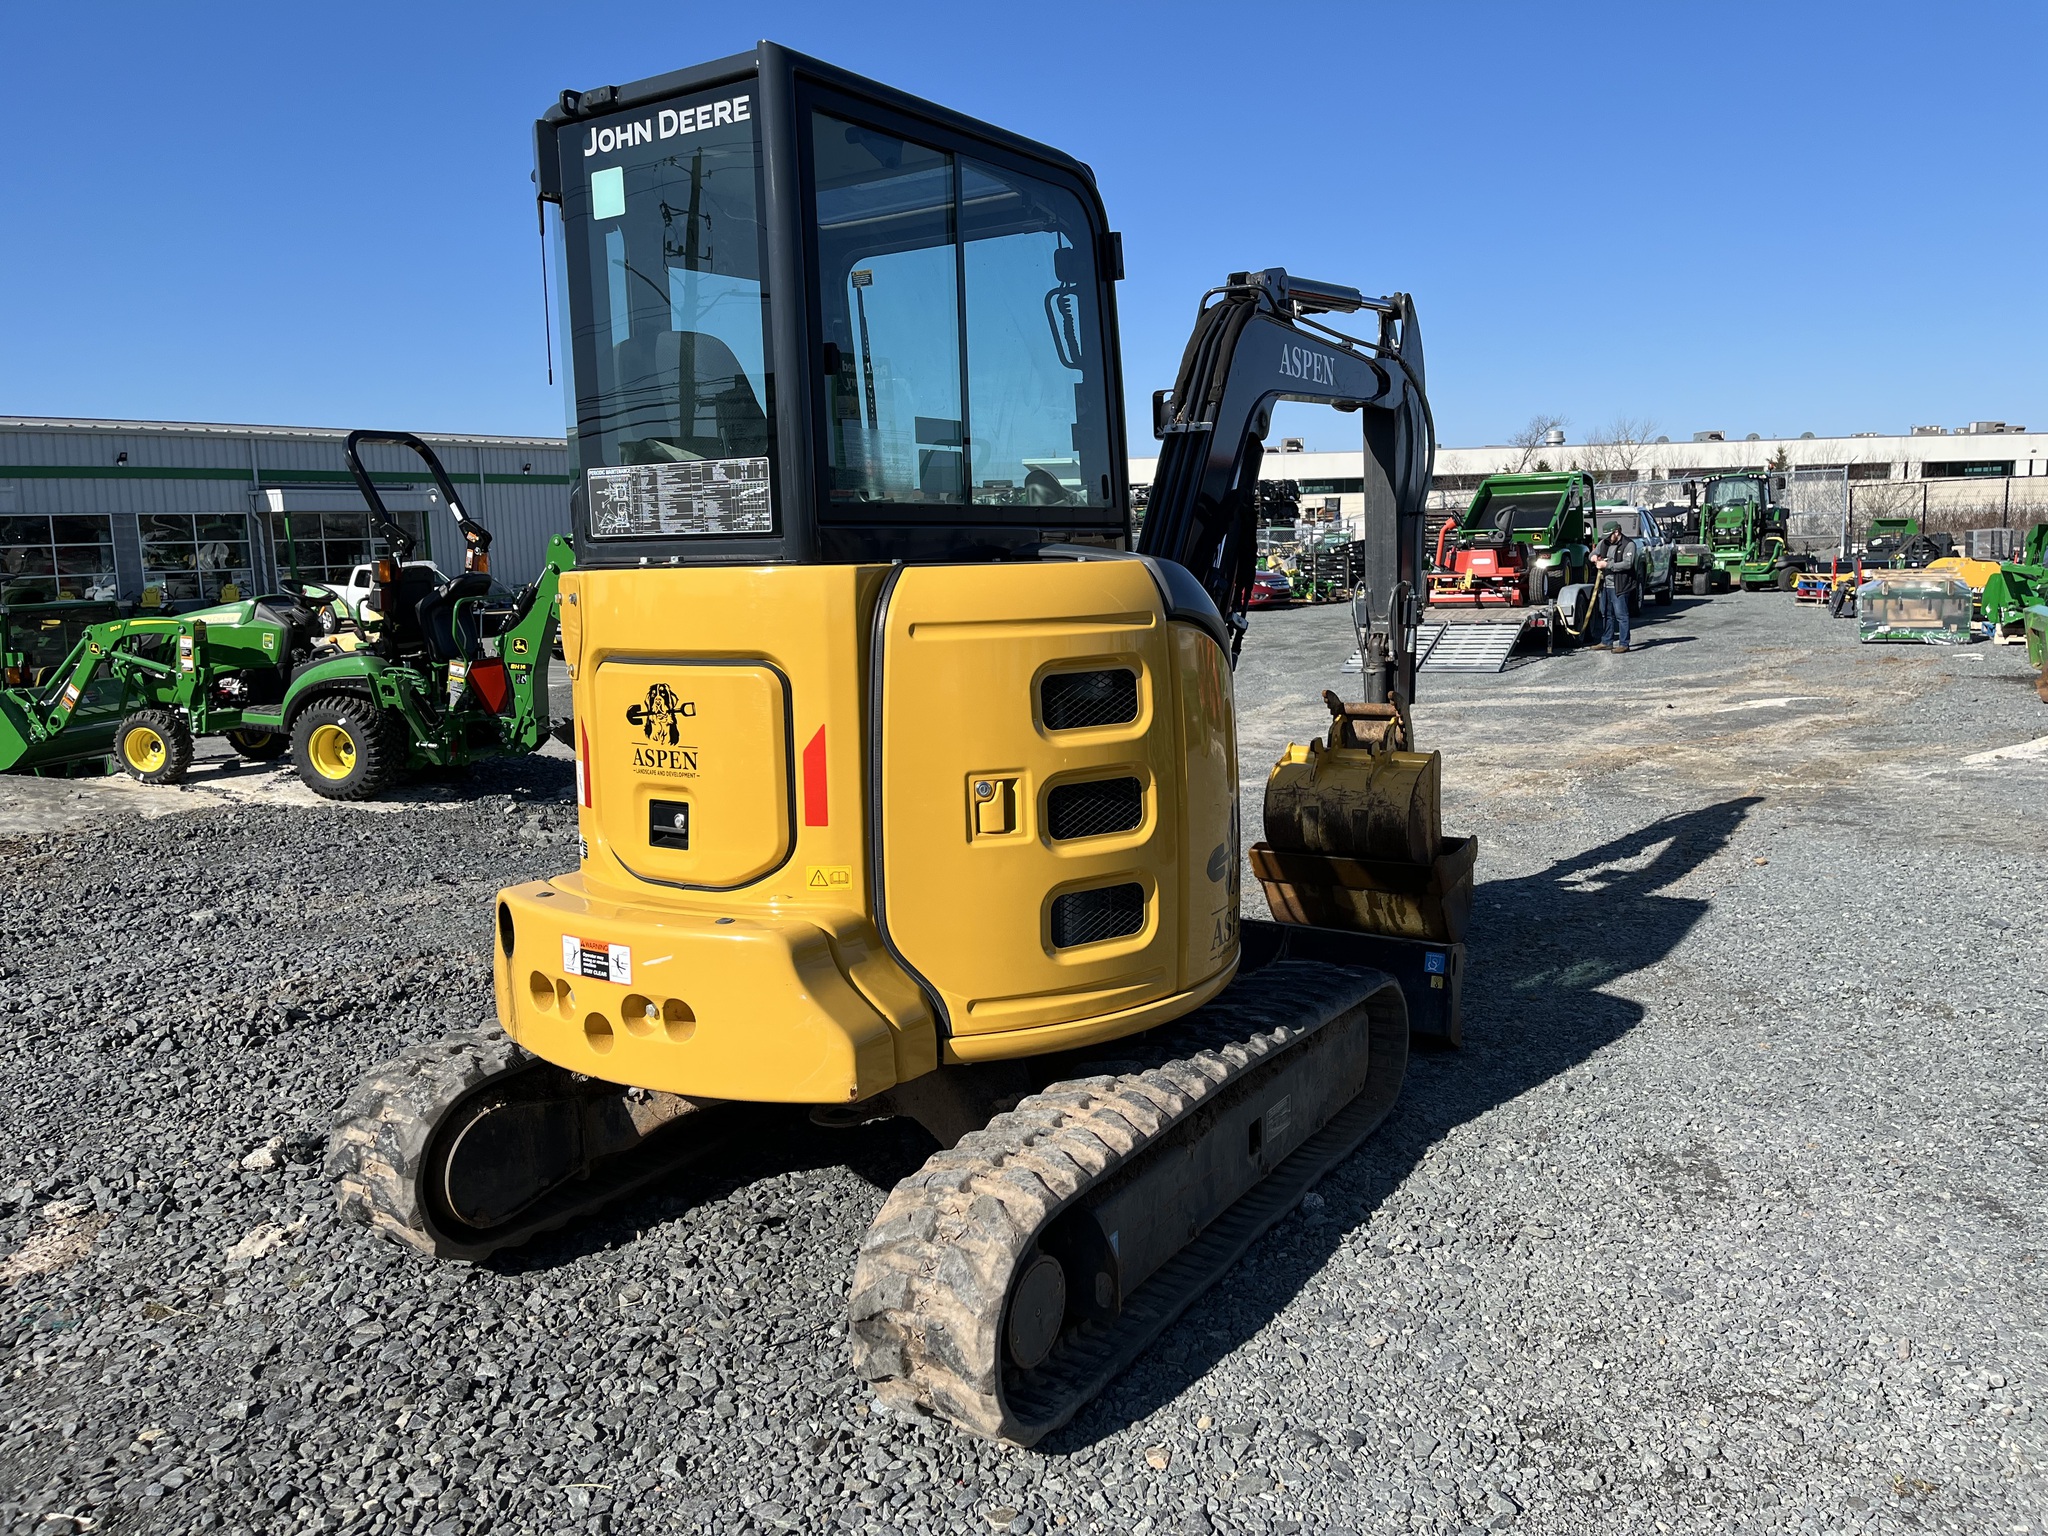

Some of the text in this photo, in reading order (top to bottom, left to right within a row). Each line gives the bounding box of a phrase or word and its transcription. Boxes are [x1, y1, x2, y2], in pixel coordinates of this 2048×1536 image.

[584, 94, 751, 157] JOHN DEERE
[1278, 343, 1335, 387] ASPEN
[632, 747, 698, 771] ASPEN
[636, 768, 657, 776] LANDSCAPE
[666, 771, 696, 779] DEVELOPMENT
[585, 941, 609, 952] WARNING
